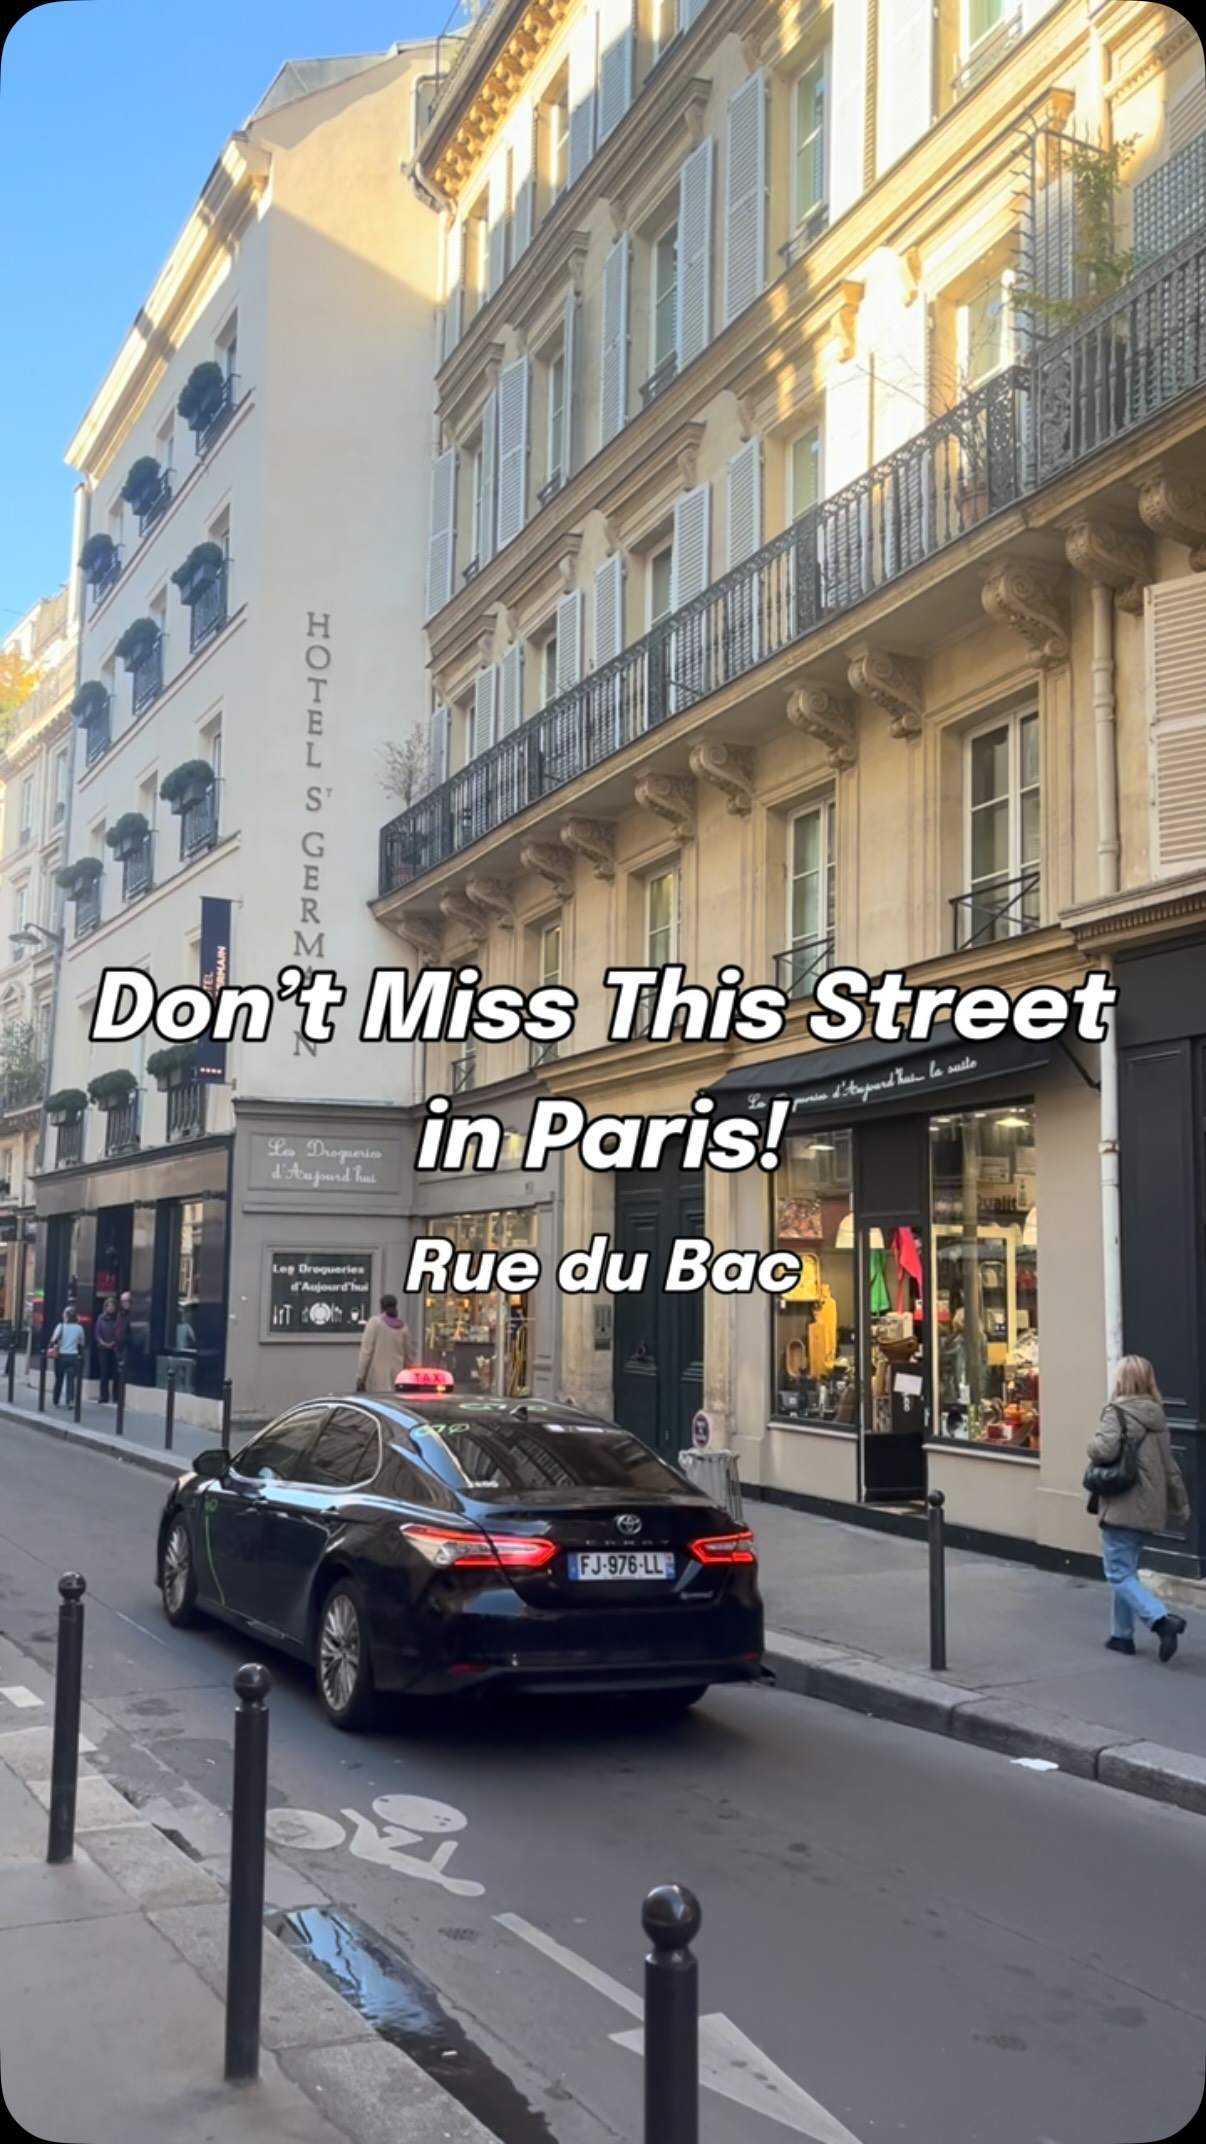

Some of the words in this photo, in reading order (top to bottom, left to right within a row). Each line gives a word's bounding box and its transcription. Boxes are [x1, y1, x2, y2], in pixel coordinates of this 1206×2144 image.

[305, 611, 331, 768] HOTEL
[293, 831, 325, 1057] GERMN
[929, 1060, 943, 1078] la
[948, 1056, 977, 1074] suite
[268, 1138, 296, 1157] Les
[306, 1138, 382, 1165] Drogueries
[271, 1162, 377, 1188] d'Aujourd'hui
[299, 1263, 365, 1275] Drogueries
[291, 1281, 369, 1293] d'Aujourd'hui
[580, 1554, 664, 1576] FJ-976-LL
